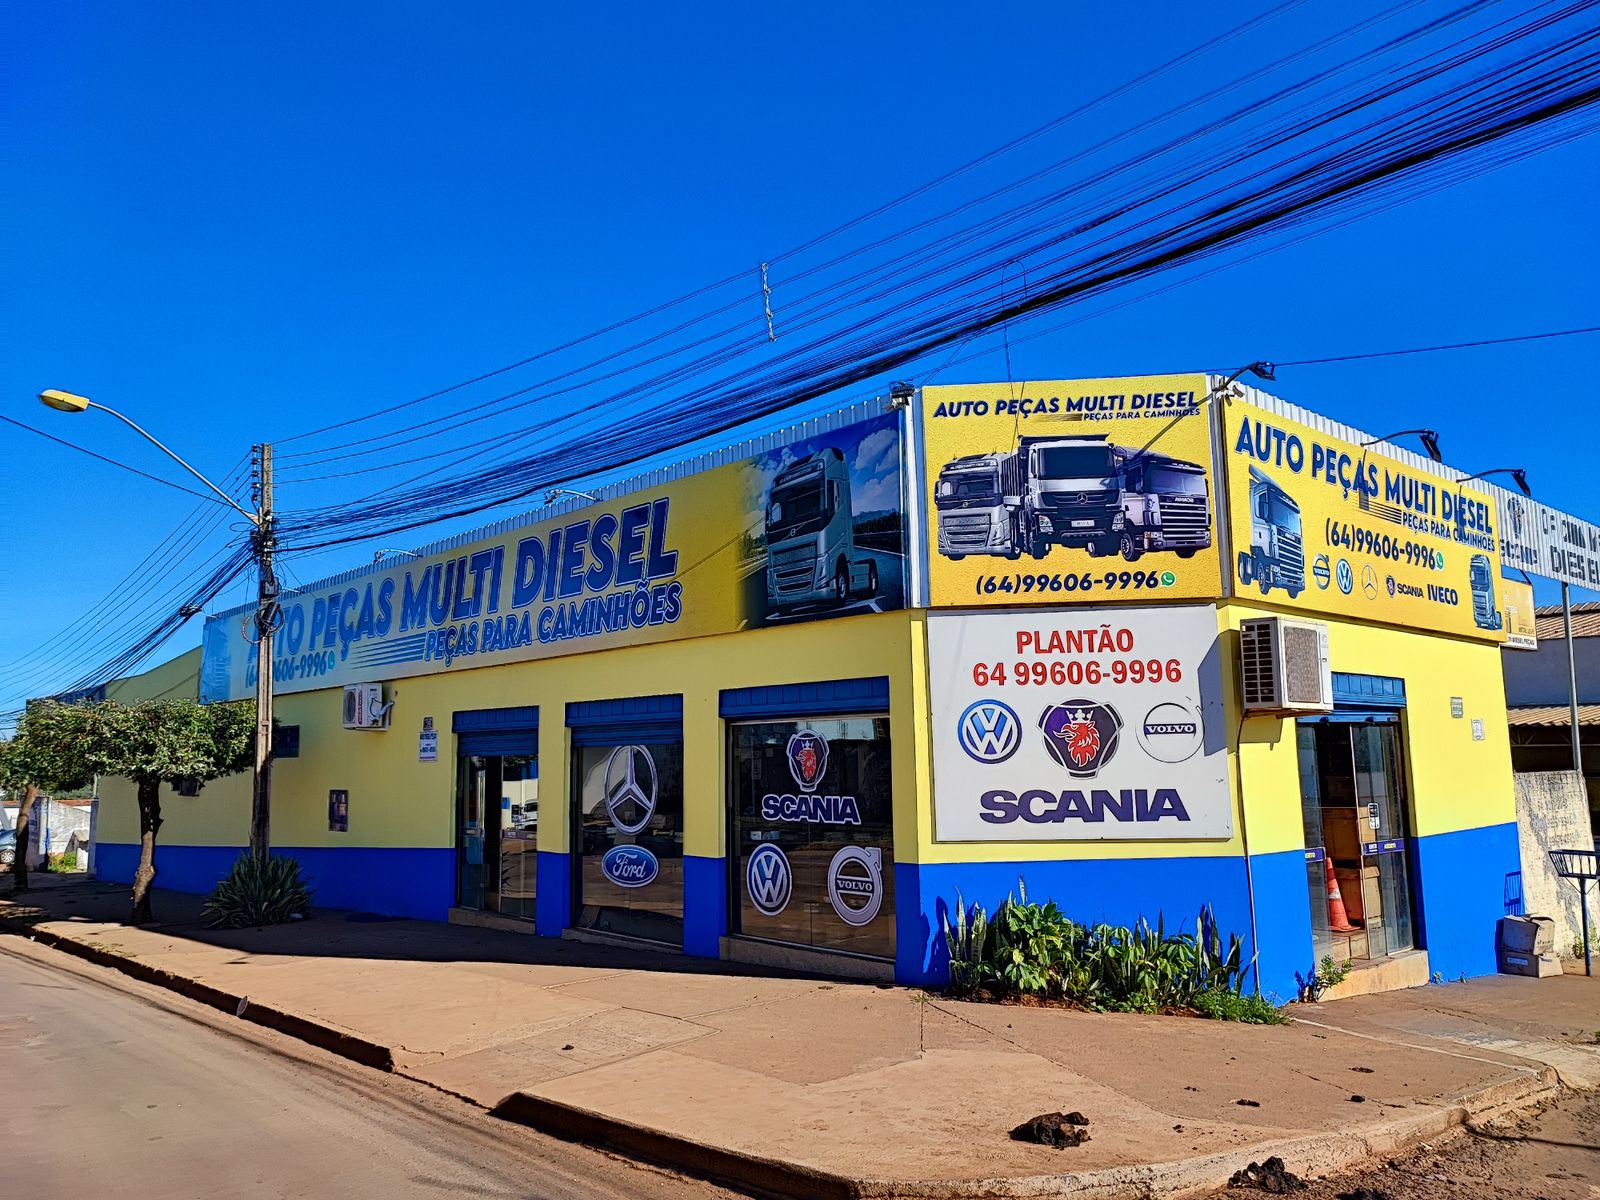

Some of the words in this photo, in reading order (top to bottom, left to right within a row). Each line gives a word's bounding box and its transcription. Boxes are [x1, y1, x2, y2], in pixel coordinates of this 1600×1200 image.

[933, 399, 989, 417] AUTO
[995, 397, 1060, 418] PEÇAS
[1066, 395, 1125, 412] MULTI
[1131, 391, 1198, 409] DIESEL
[1083, 412, 1113, 421] PEÇAS
[1116, 410, 1140, 419] PARA
[1235, 415, 1304, 474] AUTO
[1311, 442, 1378, 500] PEÇAS
[1385, 467, 1436, 516] MULTI
[1442, 489, 1493, 534] DIESEL
[1403, 511, 1428, 534] PEÇAS
[1430, 521, 1451, 540] PARA
[1326, 518, 1436, 571] (64)99606-9996
[247, 602, 305, 664] TO
[308, 576, 394, 662] PEÇAS
[399, 545, 506, 631] MULTI
[512, 496, 679, 608] DIESEL
[976, 571, 1159, 595] (64)99606-9996
[1397, 583, 1424, 599] SCANIA
[1427, 584, 1458, 606] IVECO
[425, 620, 479, 667] PEÇAS
[481, 611, 533, 651] PARA
[537, 578, 683, 644] CAMINHÕES
[1016, 624, 1134, 654] PLANTÃO
[245, 651, 327, 688] (6606-9996
[973, 662, 1007, 686] 64
[1014, 659, 1182, 685] 99606-9996
[1145, 723, 1195, 736] VOLVO
[761, 794, 861, 825] SCANIA
[979, 789, 1191, 824] SCANIA
[612, 852, 647, 879] Ford
[837, 879, 873, 892] VOLVO
